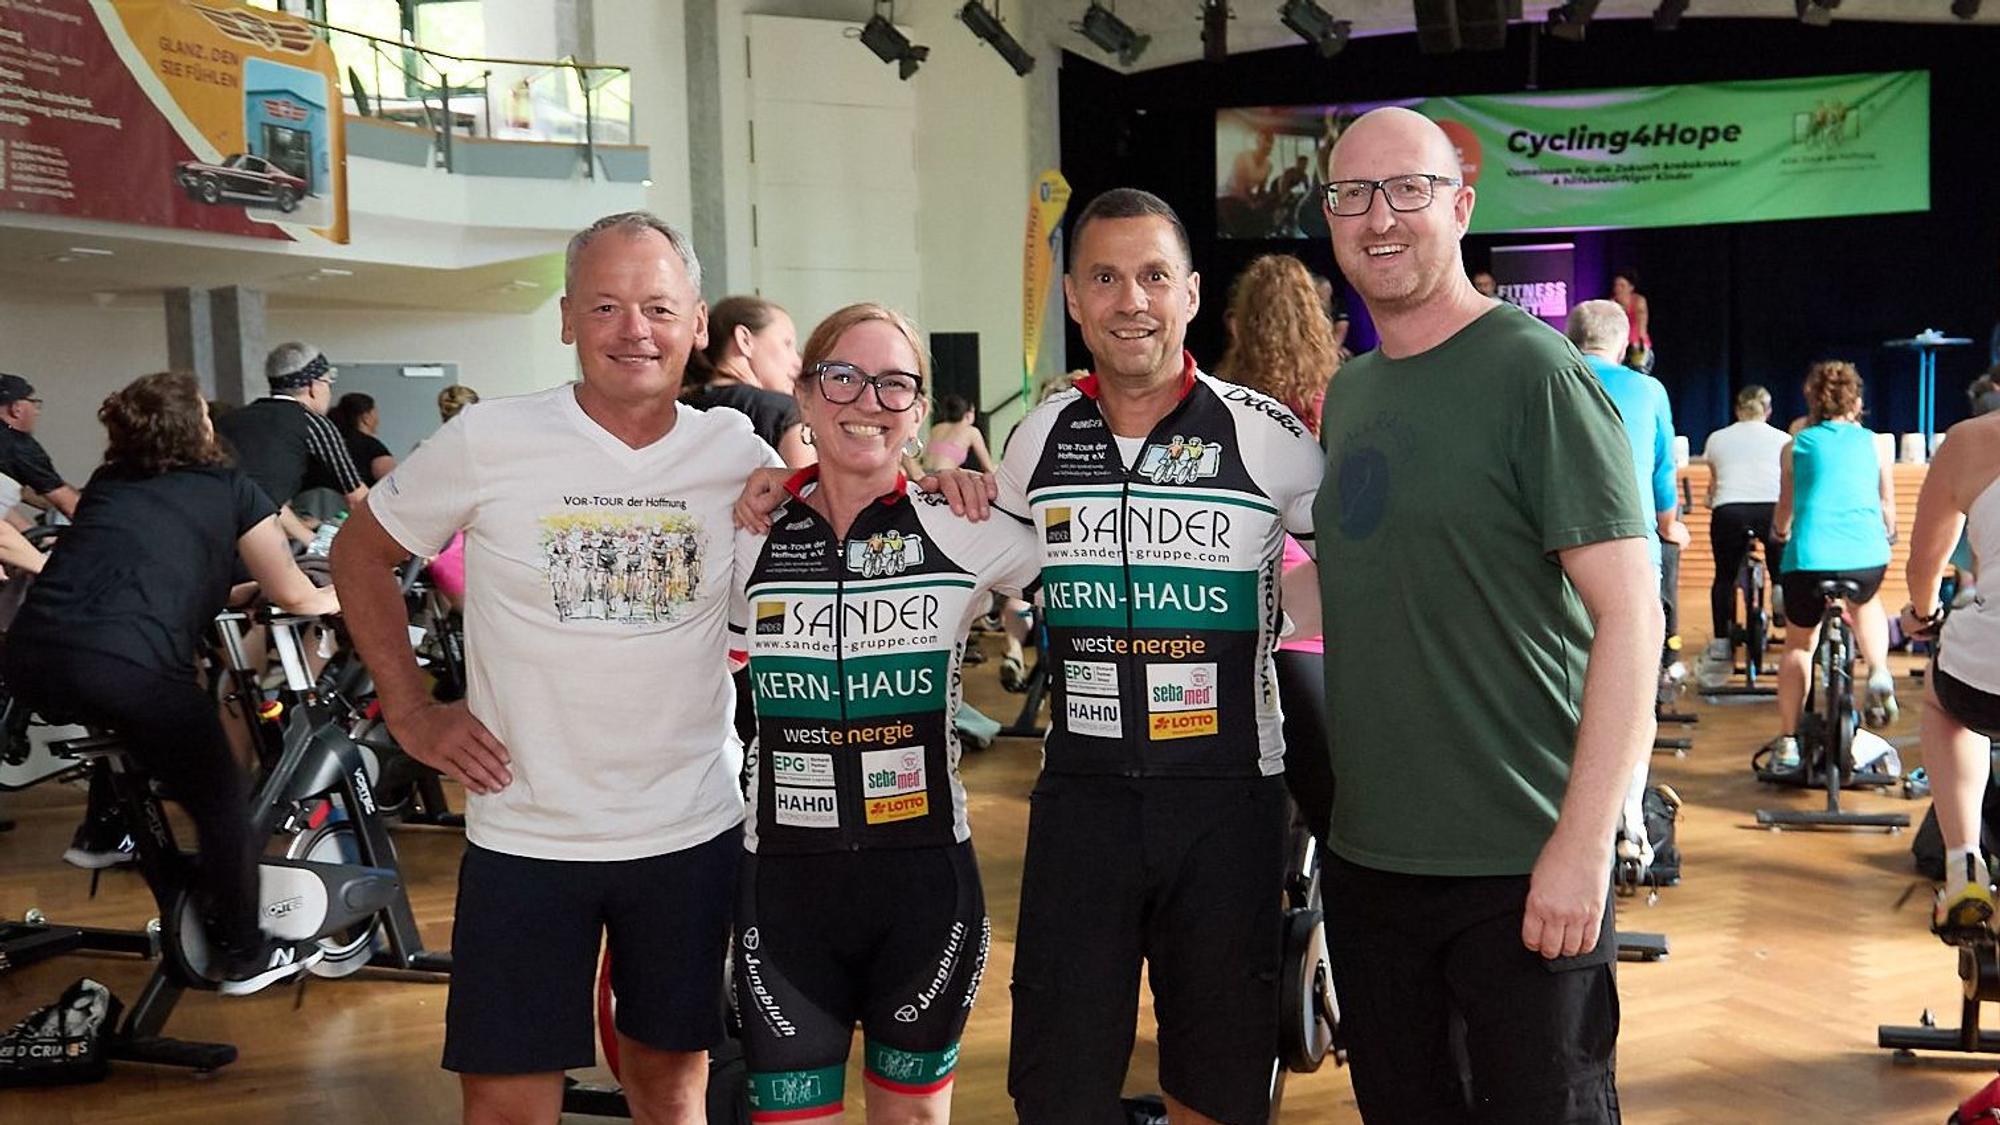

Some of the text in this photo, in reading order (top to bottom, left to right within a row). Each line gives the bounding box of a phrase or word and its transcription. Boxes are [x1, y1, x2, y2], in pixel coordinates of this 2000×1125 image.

[211, 48, 239, 65] DEN
[160, 59, 238, 88] SIE FÜHLEN
[1507, 123, 1741, 158] Cycling4Hope
[1656, 171, 1693, 181] Kinder
[1497, 281, 1567, 299] FITNESS
[1057, 452, 1090, 462] Hoffnung
[564, 496, 687, 511] VOR-TOUR der Hoffnung
[1078, 506, 1231, 549] SANDER
[771, 551, 808, 561] Hoffnung
[1049, 581, 1229, 613] KERN-HAUS
[793, 594, 939, 639] SANDER
[1065, 664, 1092, 681] EPG
[756, 668, 933, 701] KERN-HAUS
[1069, 702, 1117, 721] HAHN
[1172, 715, 1213, 728] LOTTO
[774, 755, 805, 772] EPG
[778, 794, 834, 812] HAHN
[888, 797, 924, 812] LOTTO
[917, 921, 964, 1010] Jungbluth
[745, 953, 796, 1036] Jungbluth
